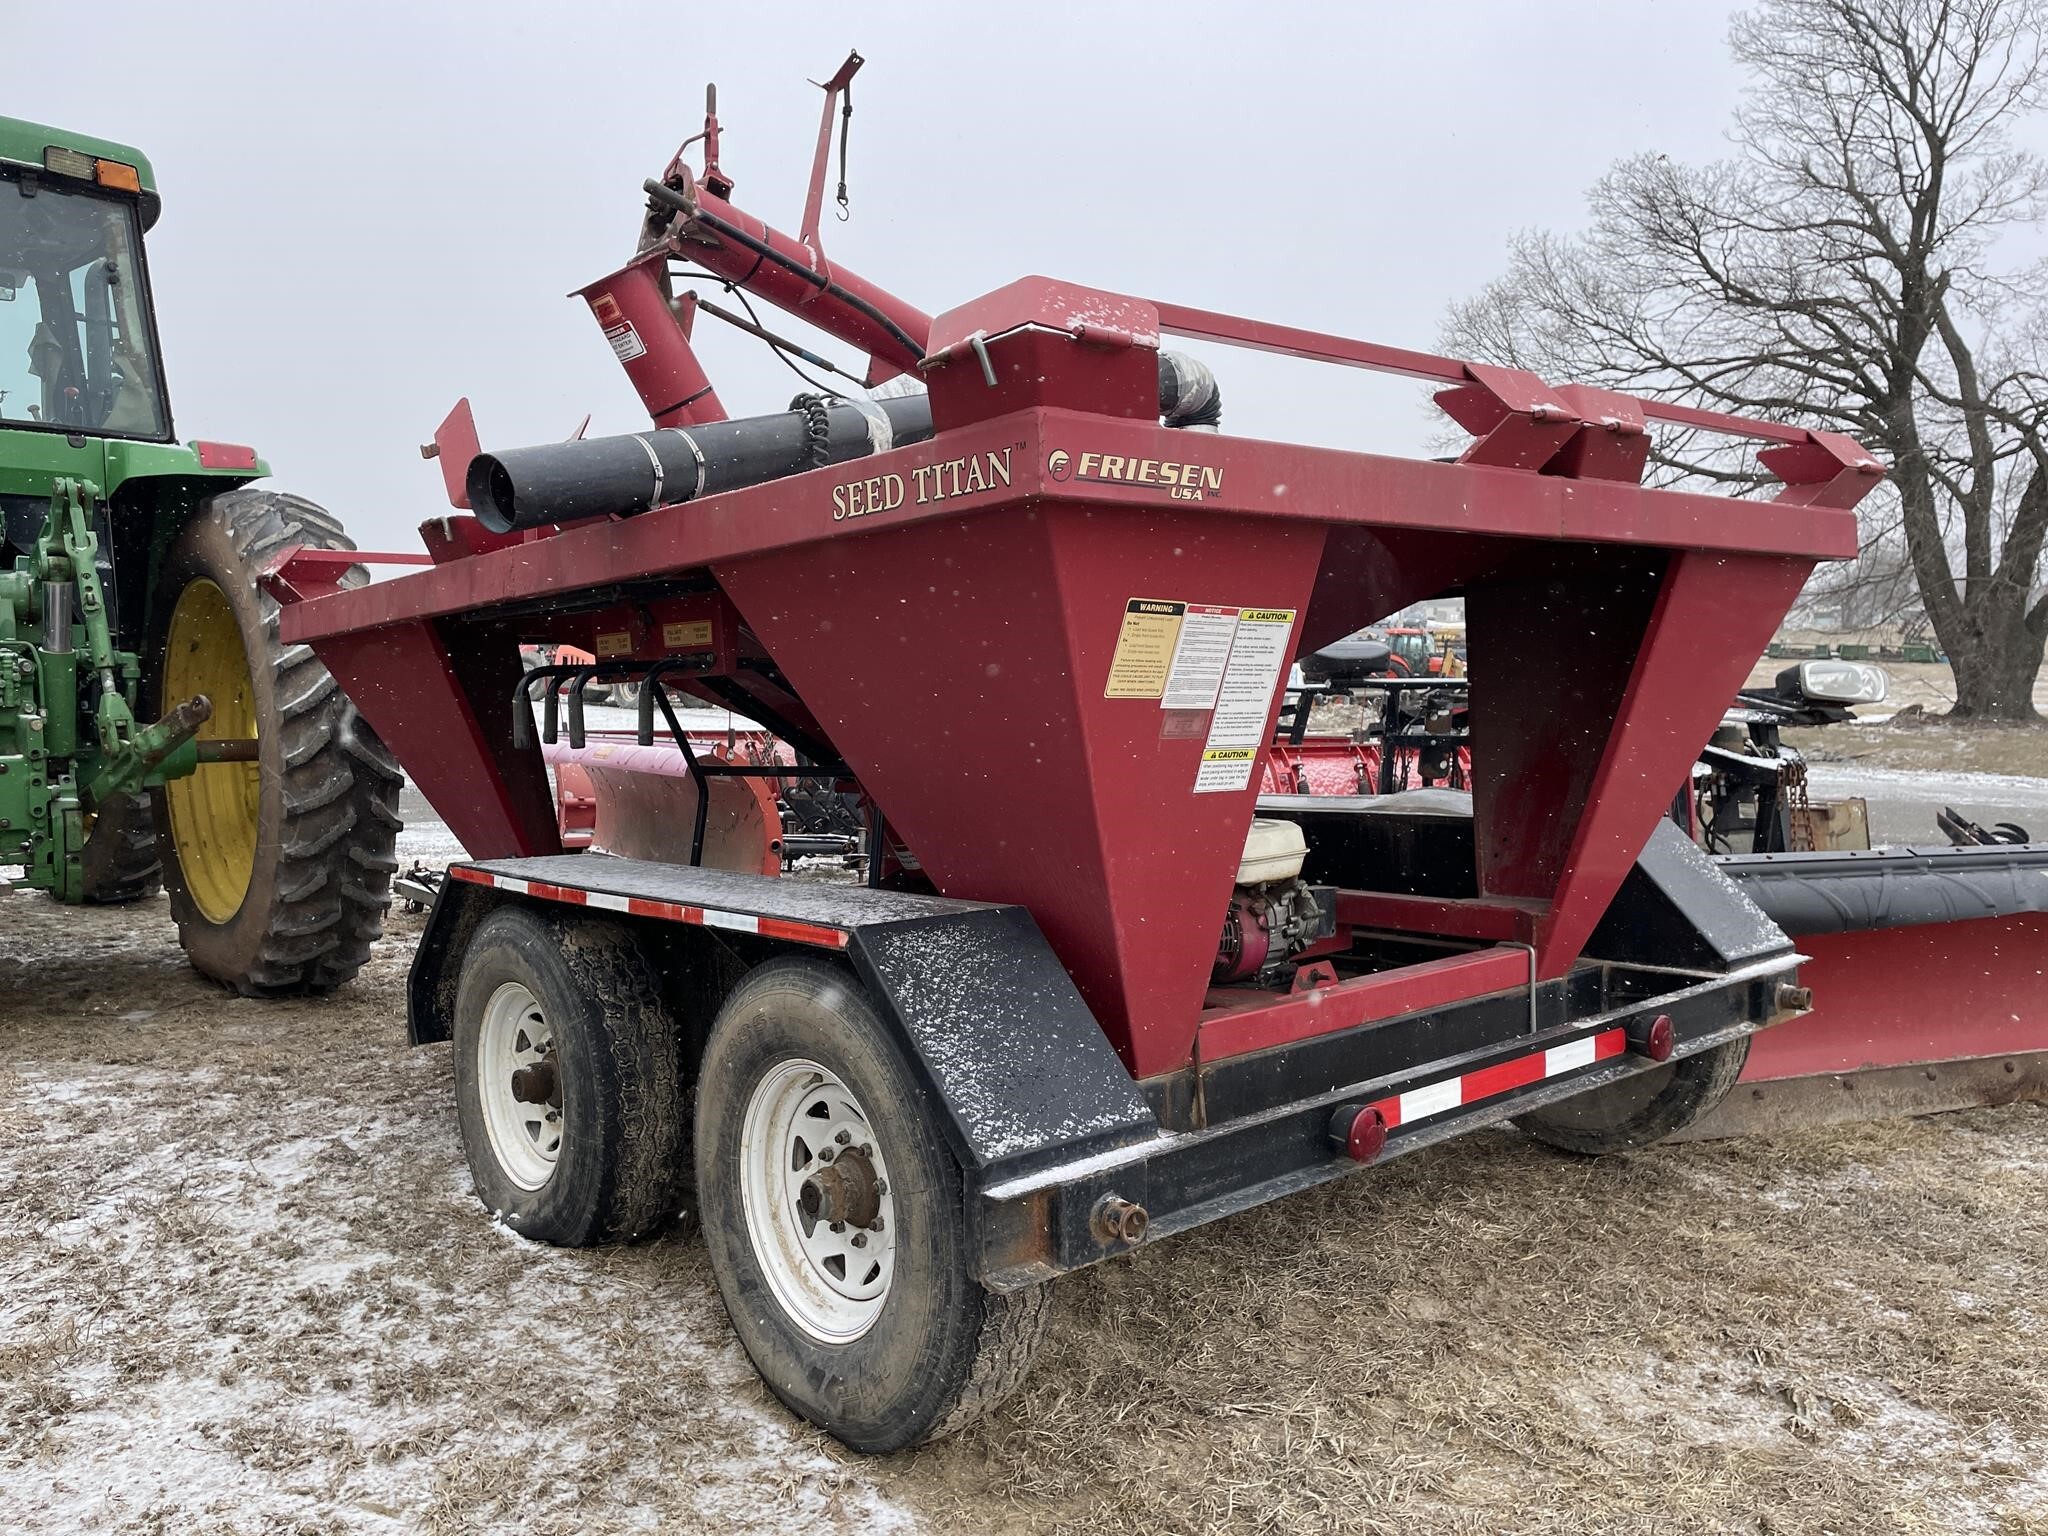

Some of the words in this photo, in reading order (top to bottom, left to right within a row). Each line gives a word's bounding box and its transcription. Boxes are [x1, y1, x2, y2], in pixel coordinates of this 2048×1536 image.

[832, 473, 905, 521] SEED
[912, 447, 1012, 504] TITAN
[1077, 452, 1225, 490] FRIESEN
[1170, 487, 1204, 501] USA
[1139, 603, 1174, 613] WARNING
